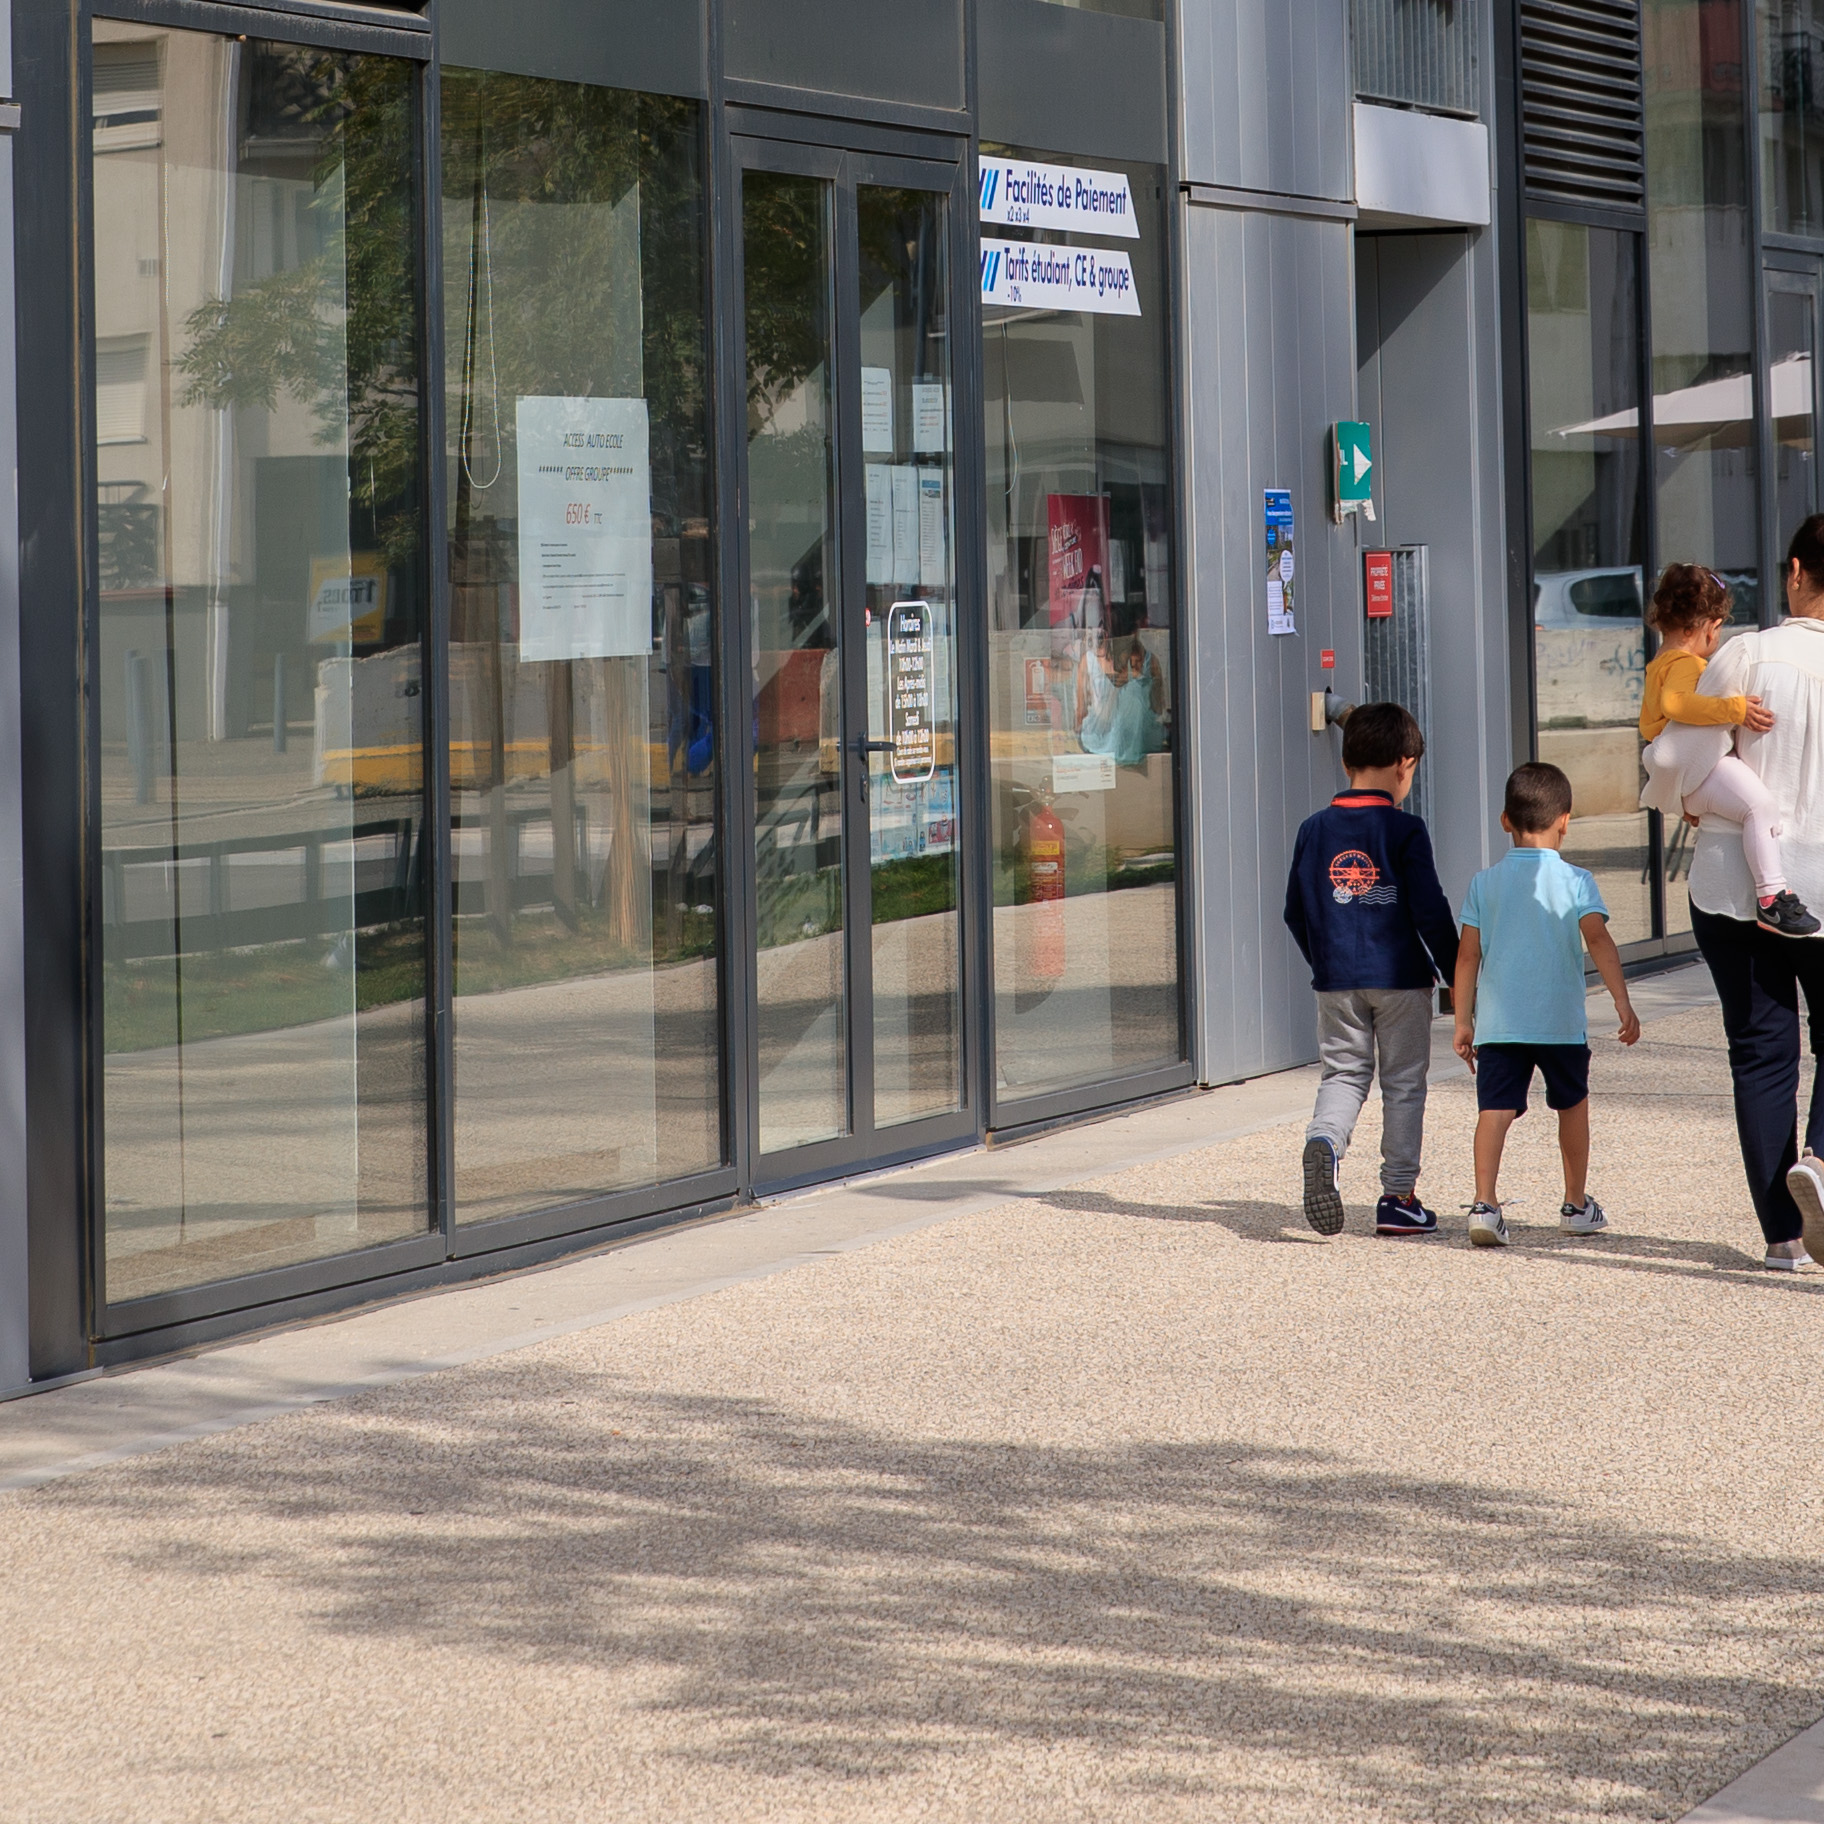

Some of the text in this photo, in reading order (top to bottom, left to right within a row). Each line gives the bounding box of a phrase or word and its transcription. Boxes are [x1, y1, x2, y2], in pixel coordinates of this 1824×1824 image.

[1005, 169, 1127, 215] Facilités de Paiement
[1007, 205, 1030, 224] x2 x3 x4
[1004, 247, 1129, 299] Tarifs étudiant, CE & groupe
[563, 433, 624, 449] ACCESS AUTO ECOLE
[565, 466, 583, 481] OFFRE
[566, 503, 583, 524] 650
[584, 503, 591, 524] €
[899, 612, 921, 632] Horaires
[905, 711, 920, 727] Samedi
